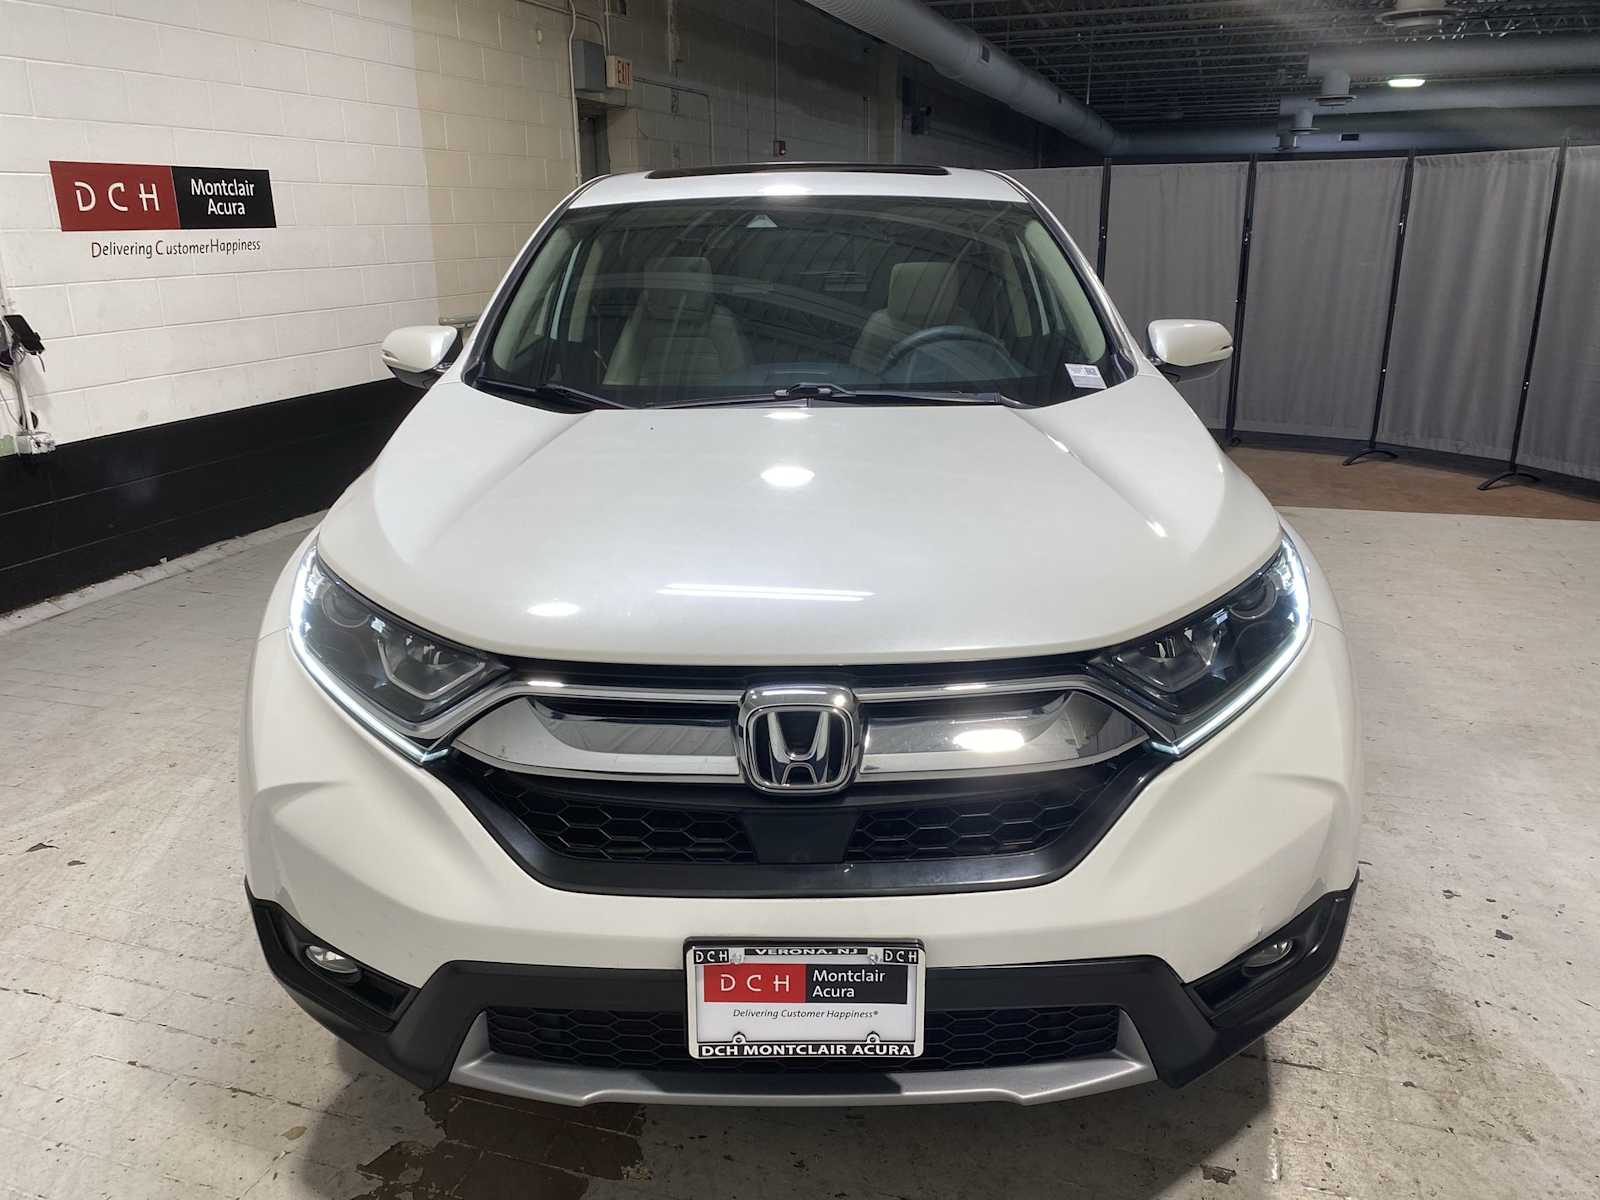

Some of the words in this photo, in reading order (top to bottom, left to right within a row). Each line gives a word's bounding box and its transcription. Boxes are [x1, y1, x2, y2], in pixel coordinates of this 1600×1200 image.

[191, 178, 255, 197] Montclair
[74, 181, 160, 212] DCH
[207, 198, 246, 215] Acura
[91, 242, 153, 259] Delivering
[155, 240, 209, 256] Customer
[210, 238, 261, 254] Happiness
[695, 950, 729, 963] DCH
[884, 950, 918, 964] DCH
[720, 974, 790, 992] DCH
[812, 969, 886, 983] Montclair
[812, 985, 855, 998] Acura
[733, 1008, 778, 1019] Delivering
[781, 1009, 824, 1018] Customer
[701, 1044, 739, 1056] DCH
[742, 1044, 848, 1056] MONTCLAIR
[852, 1044, 912, 1056] ACURA
